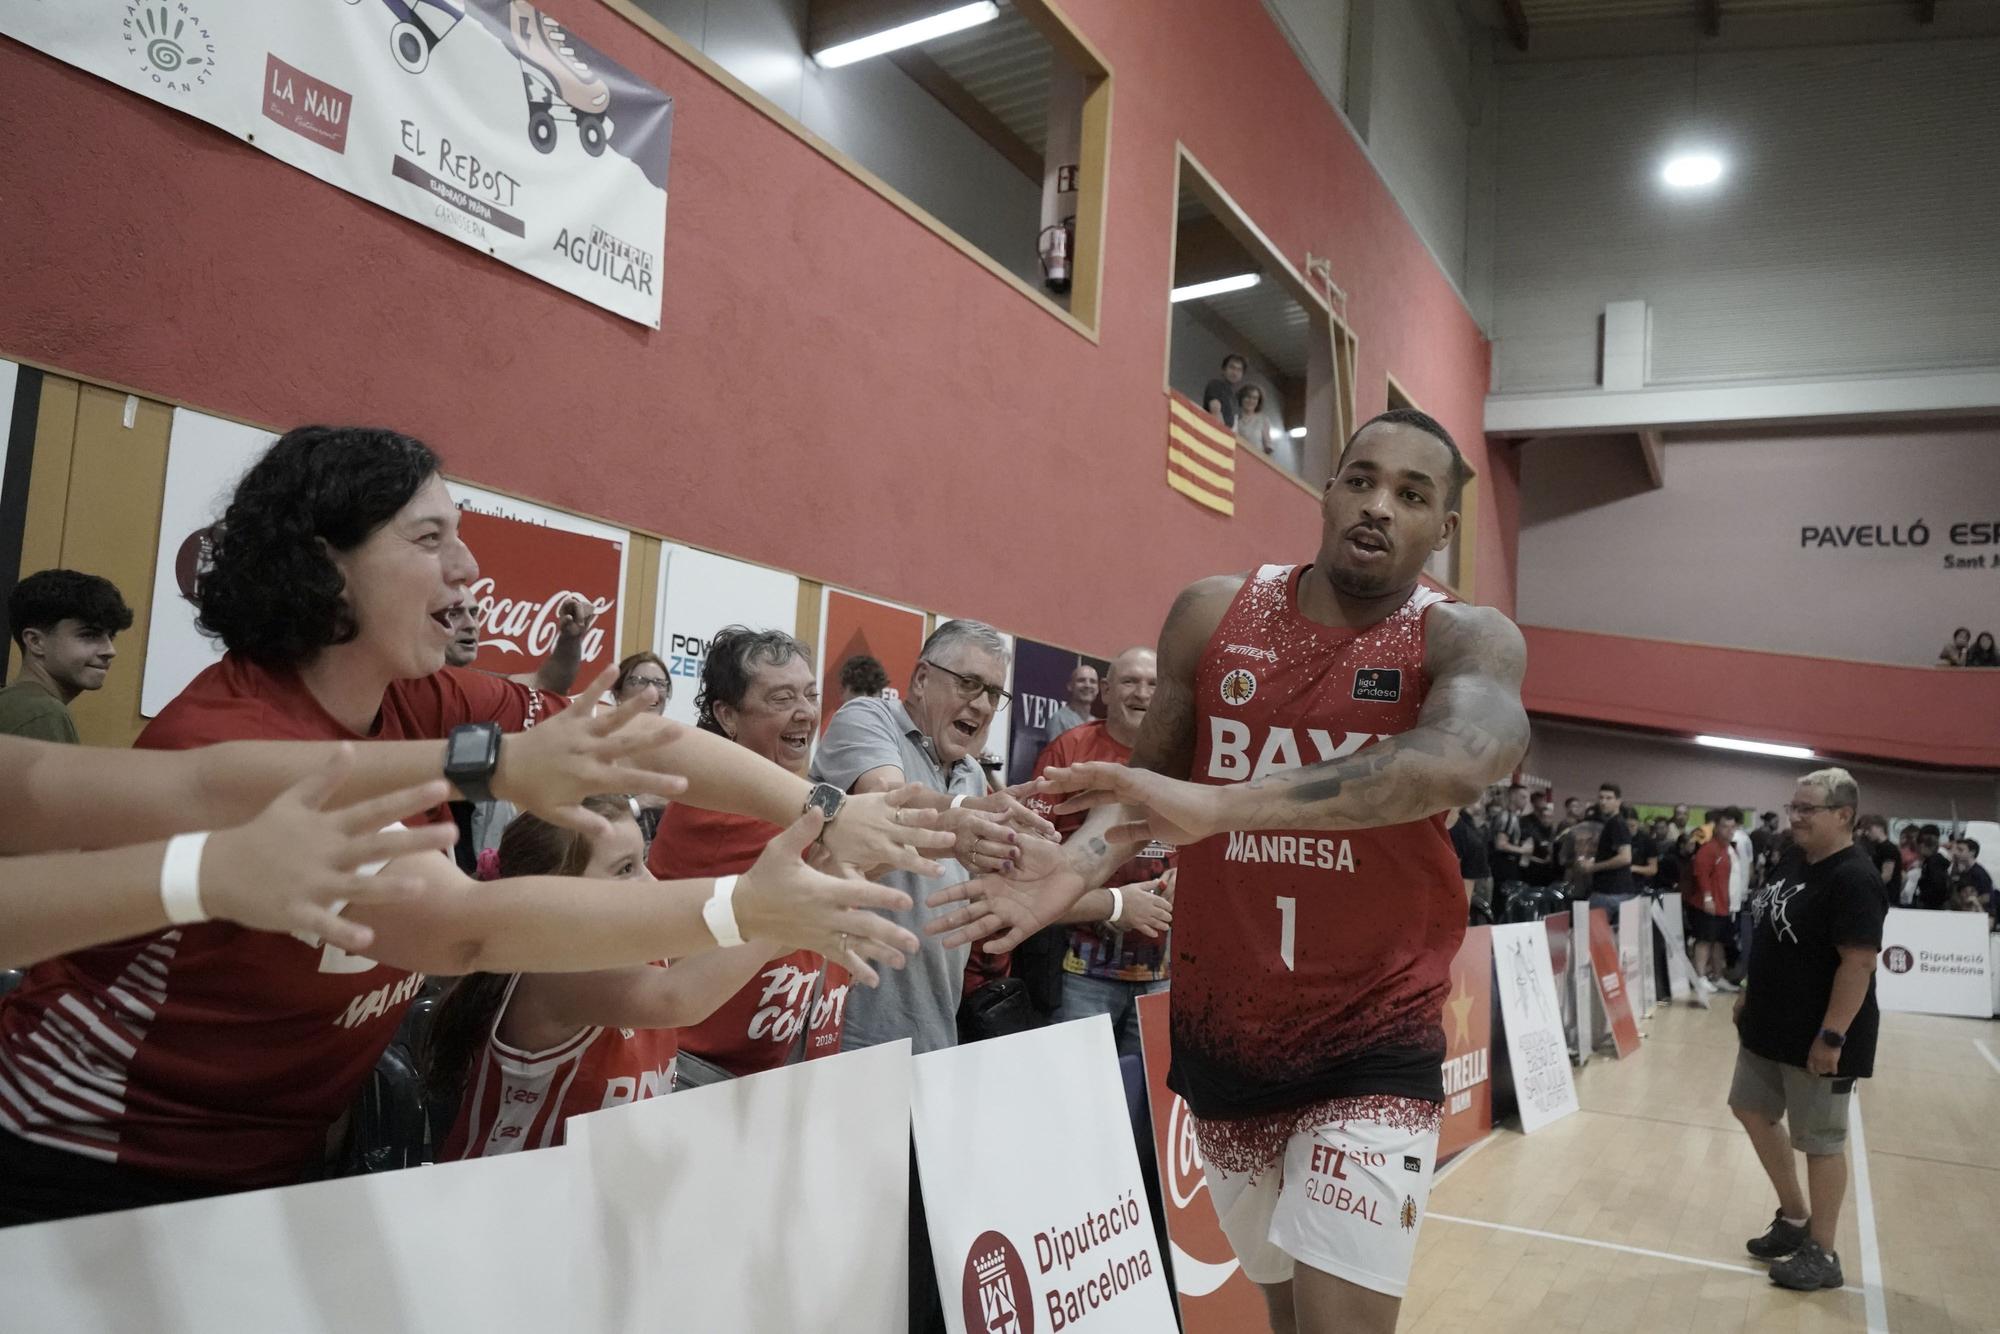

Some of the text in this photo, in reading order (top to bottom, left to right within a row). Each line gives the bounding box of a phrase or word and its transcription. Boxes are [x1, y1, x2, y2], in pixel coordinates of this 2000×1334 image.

[272, 68, 343, 125] LA NAU
[400, 119, 521, 207] EL REBOST
[553, 227, 653, 296] AGUILAR
[590, 225, 653, 271] FUSTERIA
[1801, 518, 1930, 548] PAVELLÓ
[1944, 553, 1985, 569] Sant
[1356, 687, 1397, 698] endesa
[1225, 830, 1355, 874] MANRESA
[1276, 895, 1297, 973] 1
[1311, 1143, 1348, 1181] ETL
[1305, 1177, 1383, 1226] GLOBAL
[1033, 1189, 1140, 1275] Diputació
[1045, 1249, 1153, 1334] Barcelona
